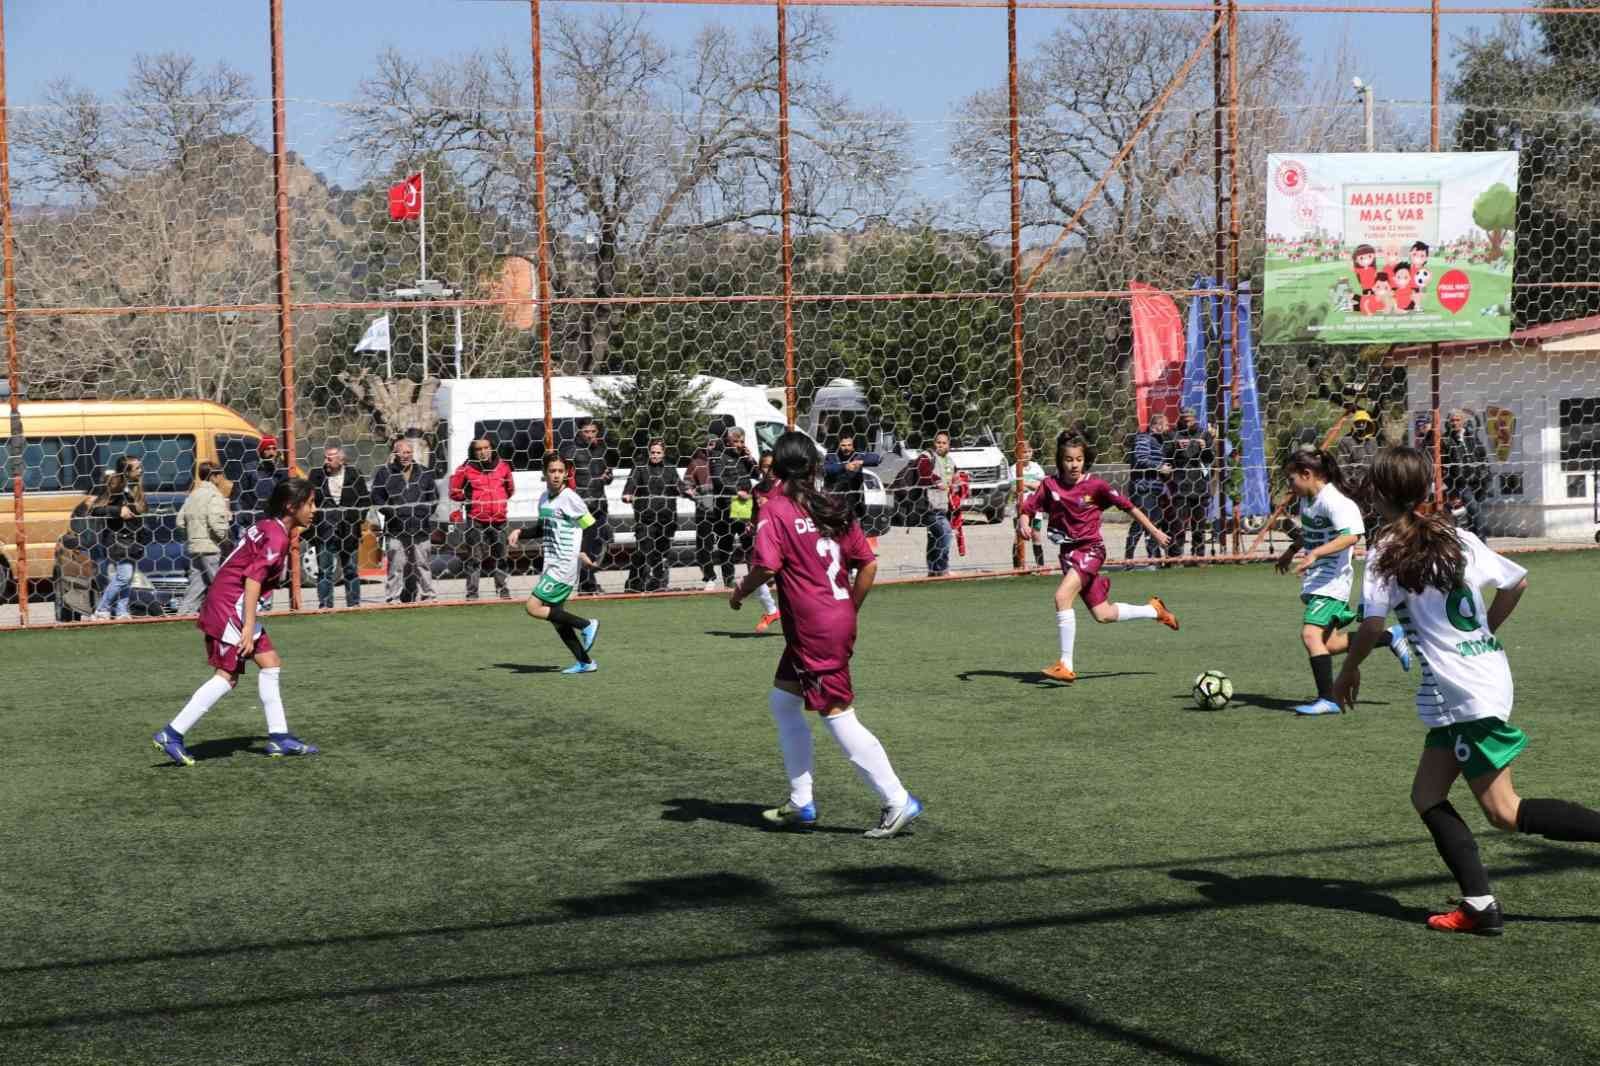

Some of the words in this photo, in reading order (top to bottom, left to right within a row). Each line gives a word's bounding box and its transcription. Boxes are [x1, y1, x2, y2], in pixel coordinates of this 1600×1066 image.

[1351, 191, 1433, 206] MAHALLEDE
[1398, 207, 1424, 221] VAR
[815, 537, 849, 600] 2
[537, 578, 555, 593] 10
[1311, 600, 1328, 615] 7
[1455, 734, 1472, 762] 6
